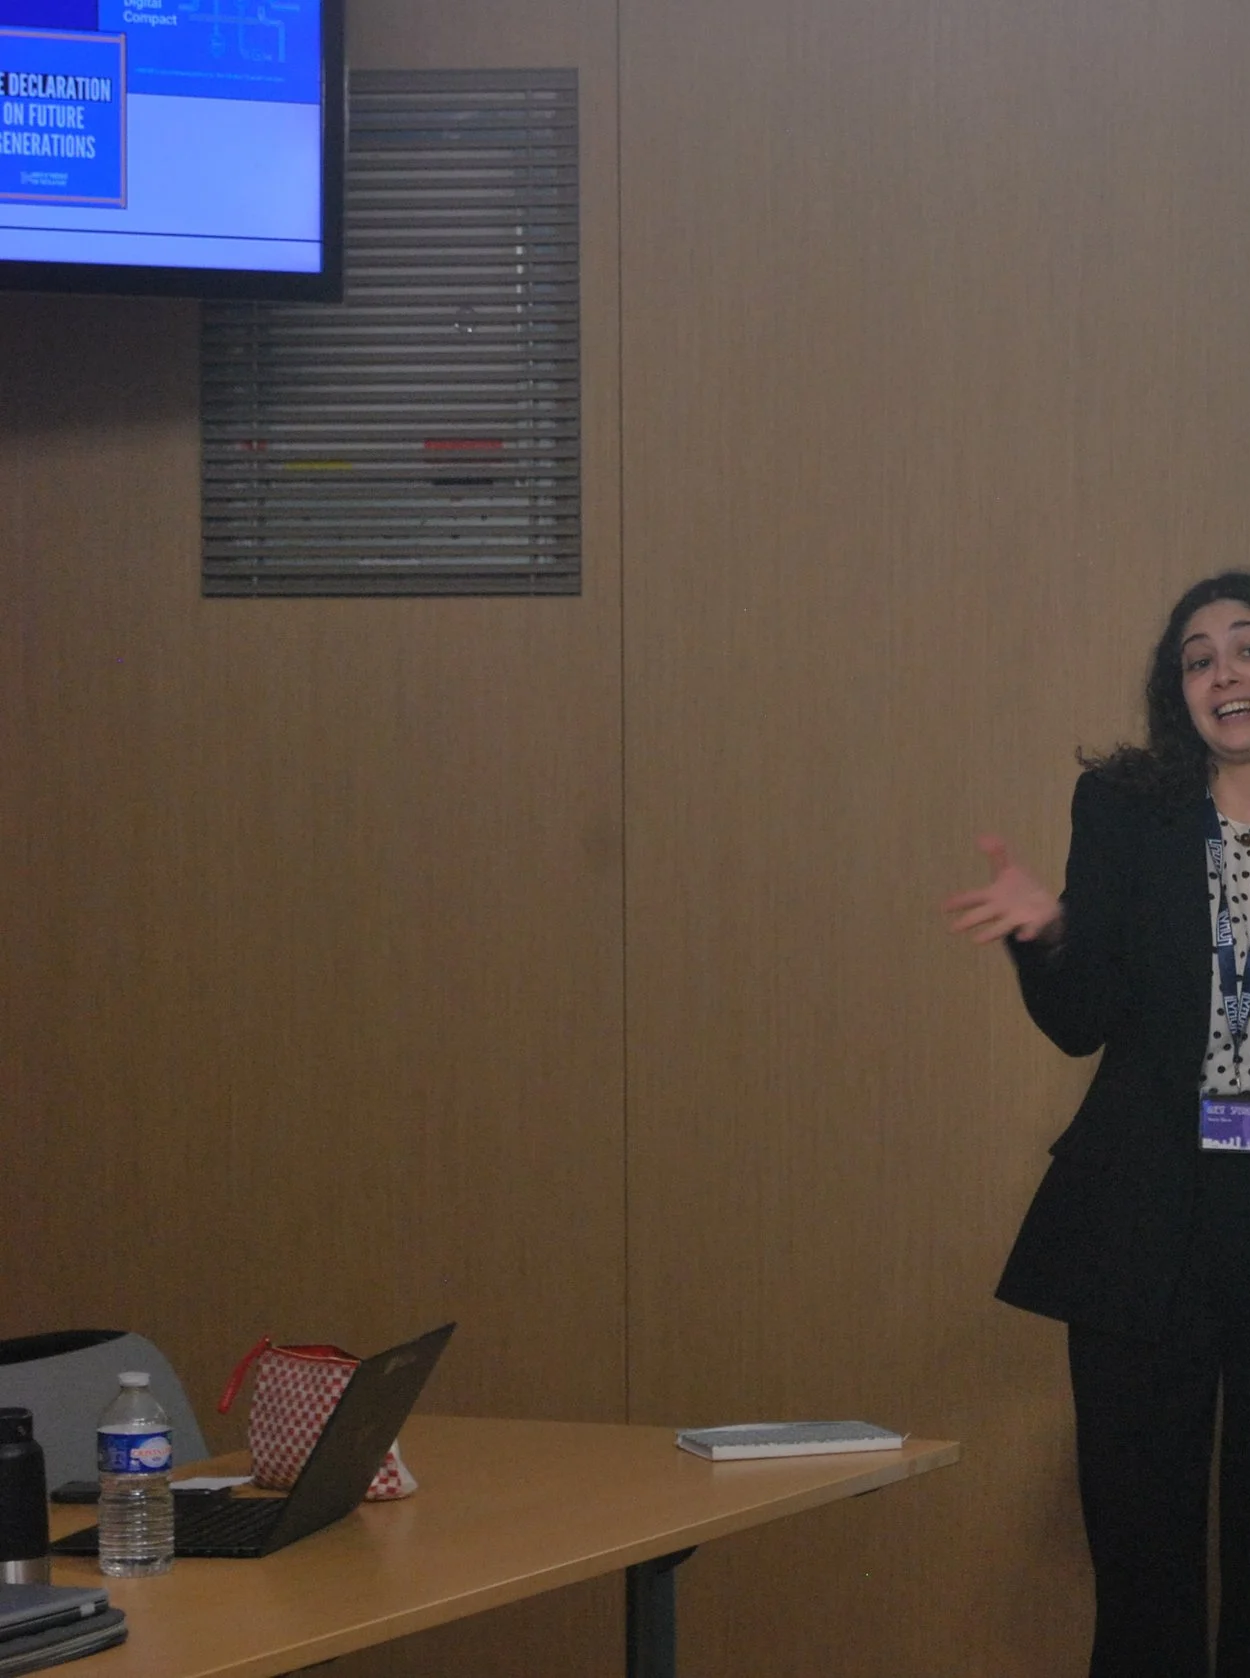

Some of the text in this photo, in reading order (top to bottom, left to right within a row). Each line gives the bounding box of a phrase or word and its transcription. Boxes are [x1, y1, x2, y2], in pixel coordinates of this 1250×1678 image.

[123, 10, 177, 27] Compact
[8, 73, 111, 102] DECLARATION
[4, 102, 84, 129] ON FUTURE
[0, 131, 96, 159] ENERATIONS
